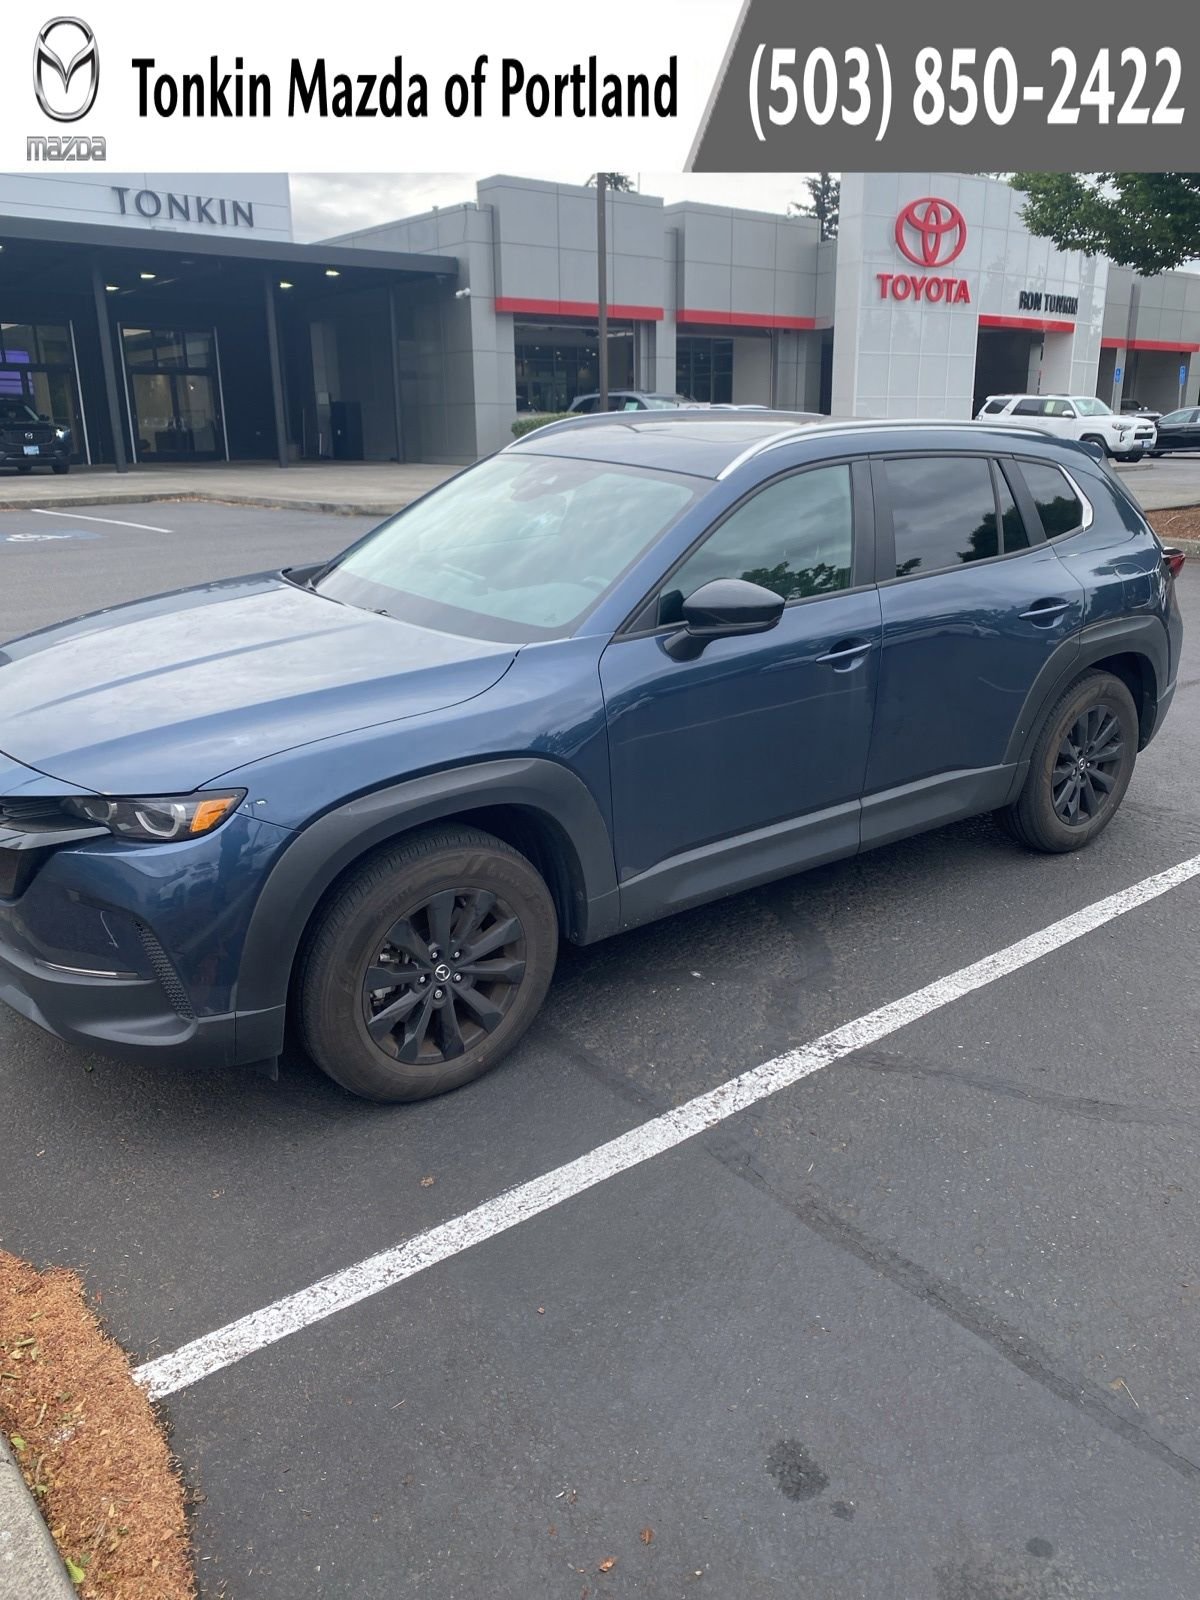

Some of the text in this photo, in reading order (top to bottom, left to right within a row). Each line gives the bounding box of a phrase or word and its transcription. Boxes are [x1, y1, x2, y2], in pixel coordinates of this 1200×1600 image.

[111, 186, 255, 228] TONKIN
[876, 273, 971, 304] TOYOTA
[1018, 290, 1043, 312] RON
